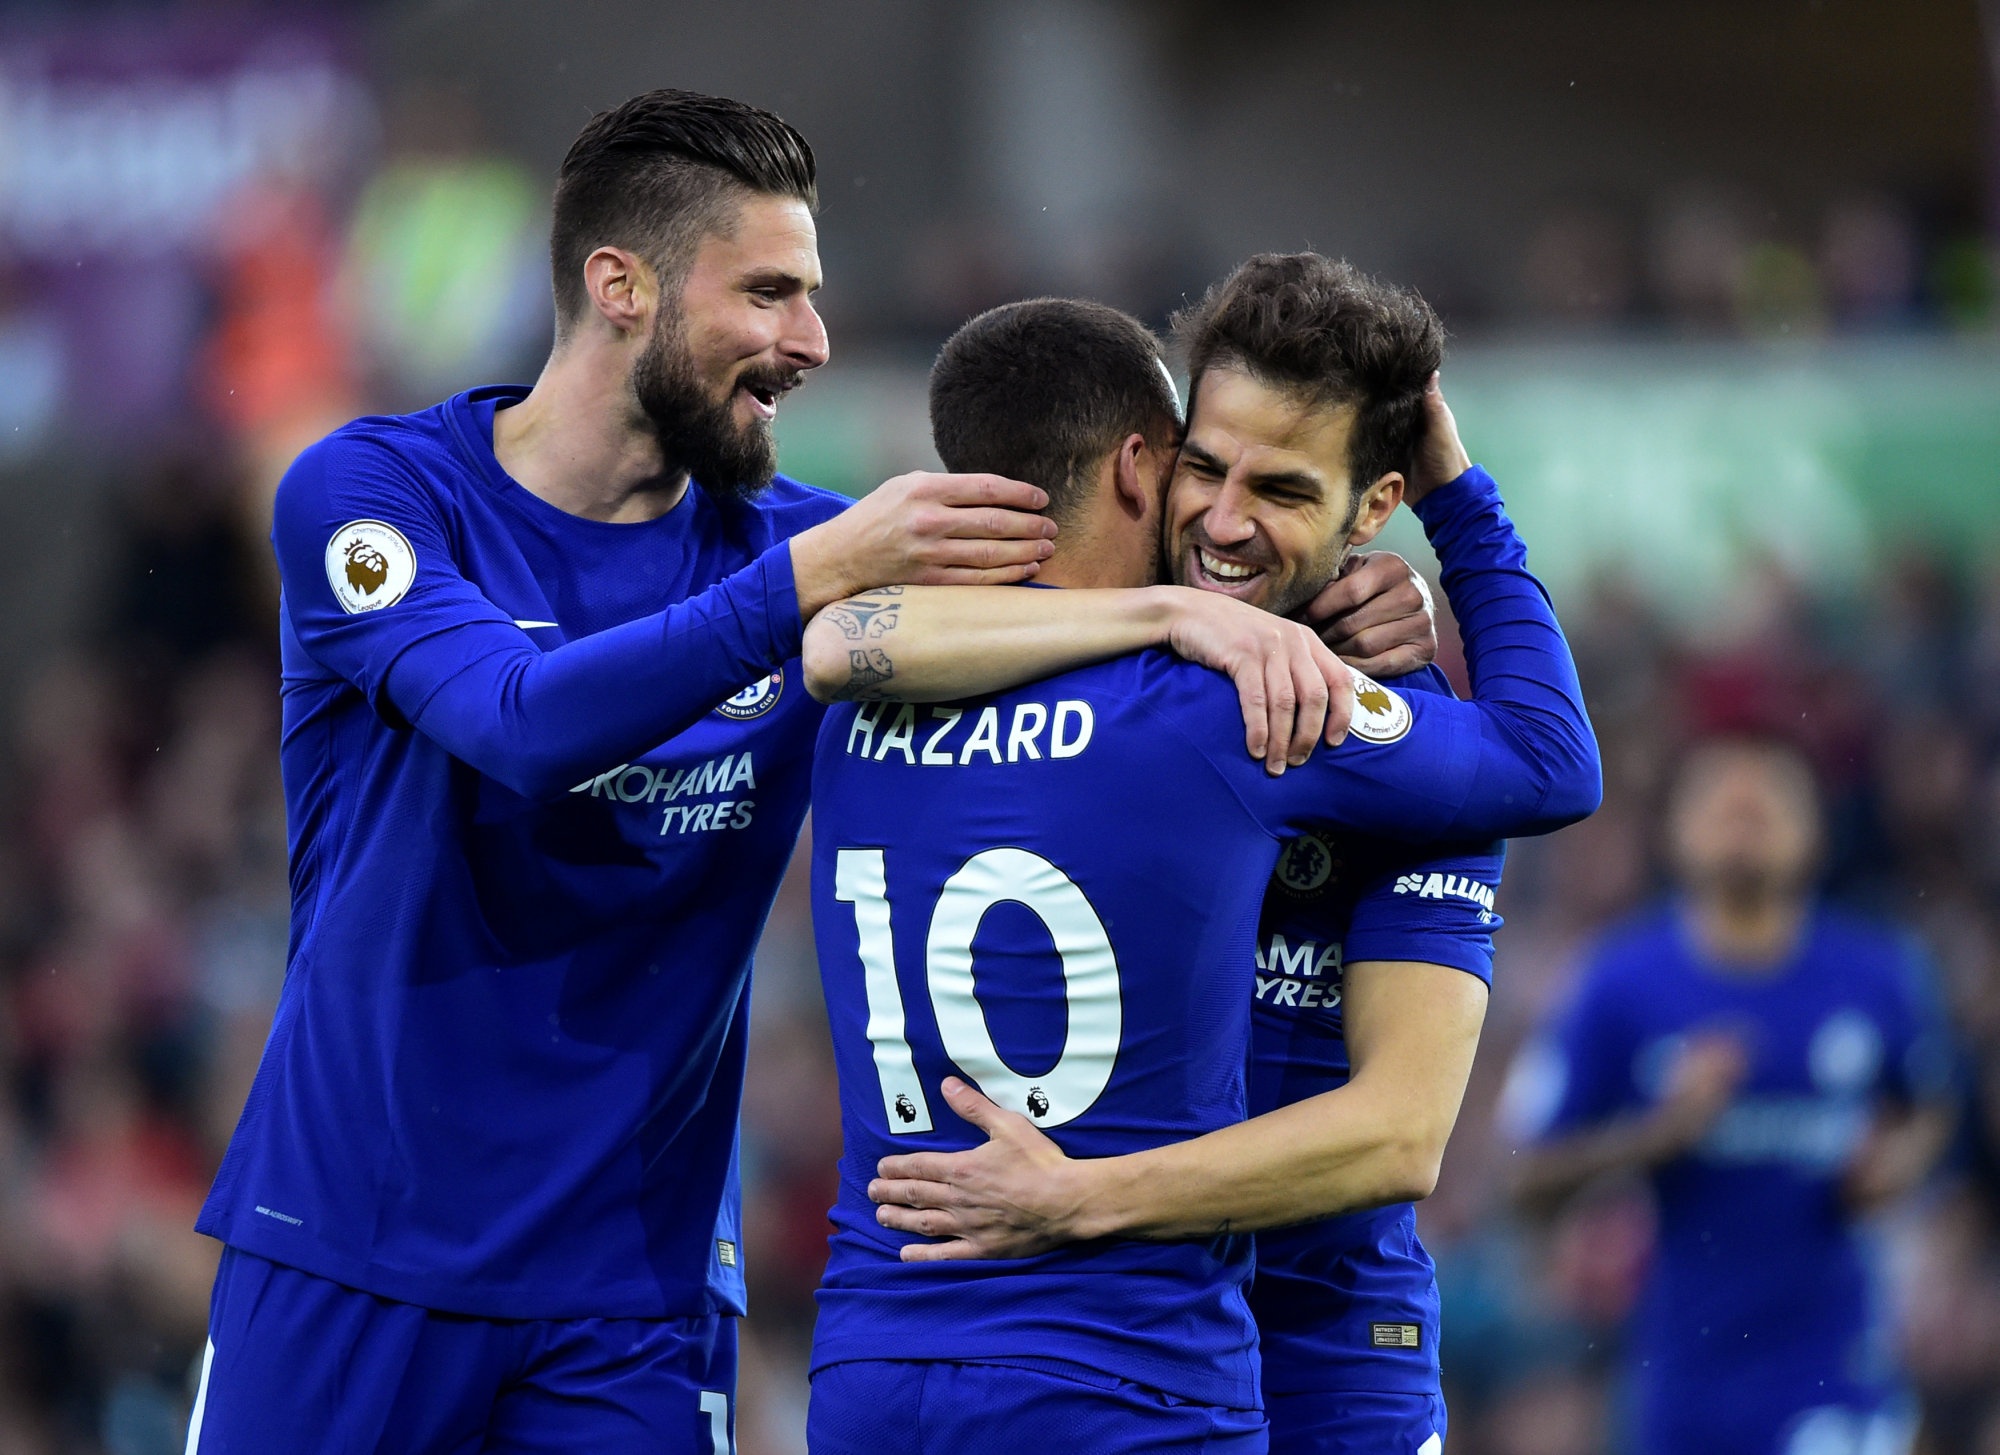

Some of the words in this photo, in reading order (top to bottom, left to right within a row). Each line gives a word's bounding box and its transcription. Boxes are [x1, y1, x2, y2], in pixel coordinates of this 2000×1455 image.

[358, 599, 382, 612] League
[721, 704, 758, 716] FOOTBALL
[759, 693, 775, 709] CLUB
[847, 699, 1095, 766] HAZARD
[1363, 722, 1391, 734] Premier
[568, 751, 757, 804] KOHAMA
[660, 800, 756, 836] TYRES
[835, 846, 1122, 1135] 10
[1255, 975, 1343, 1009] YRES
